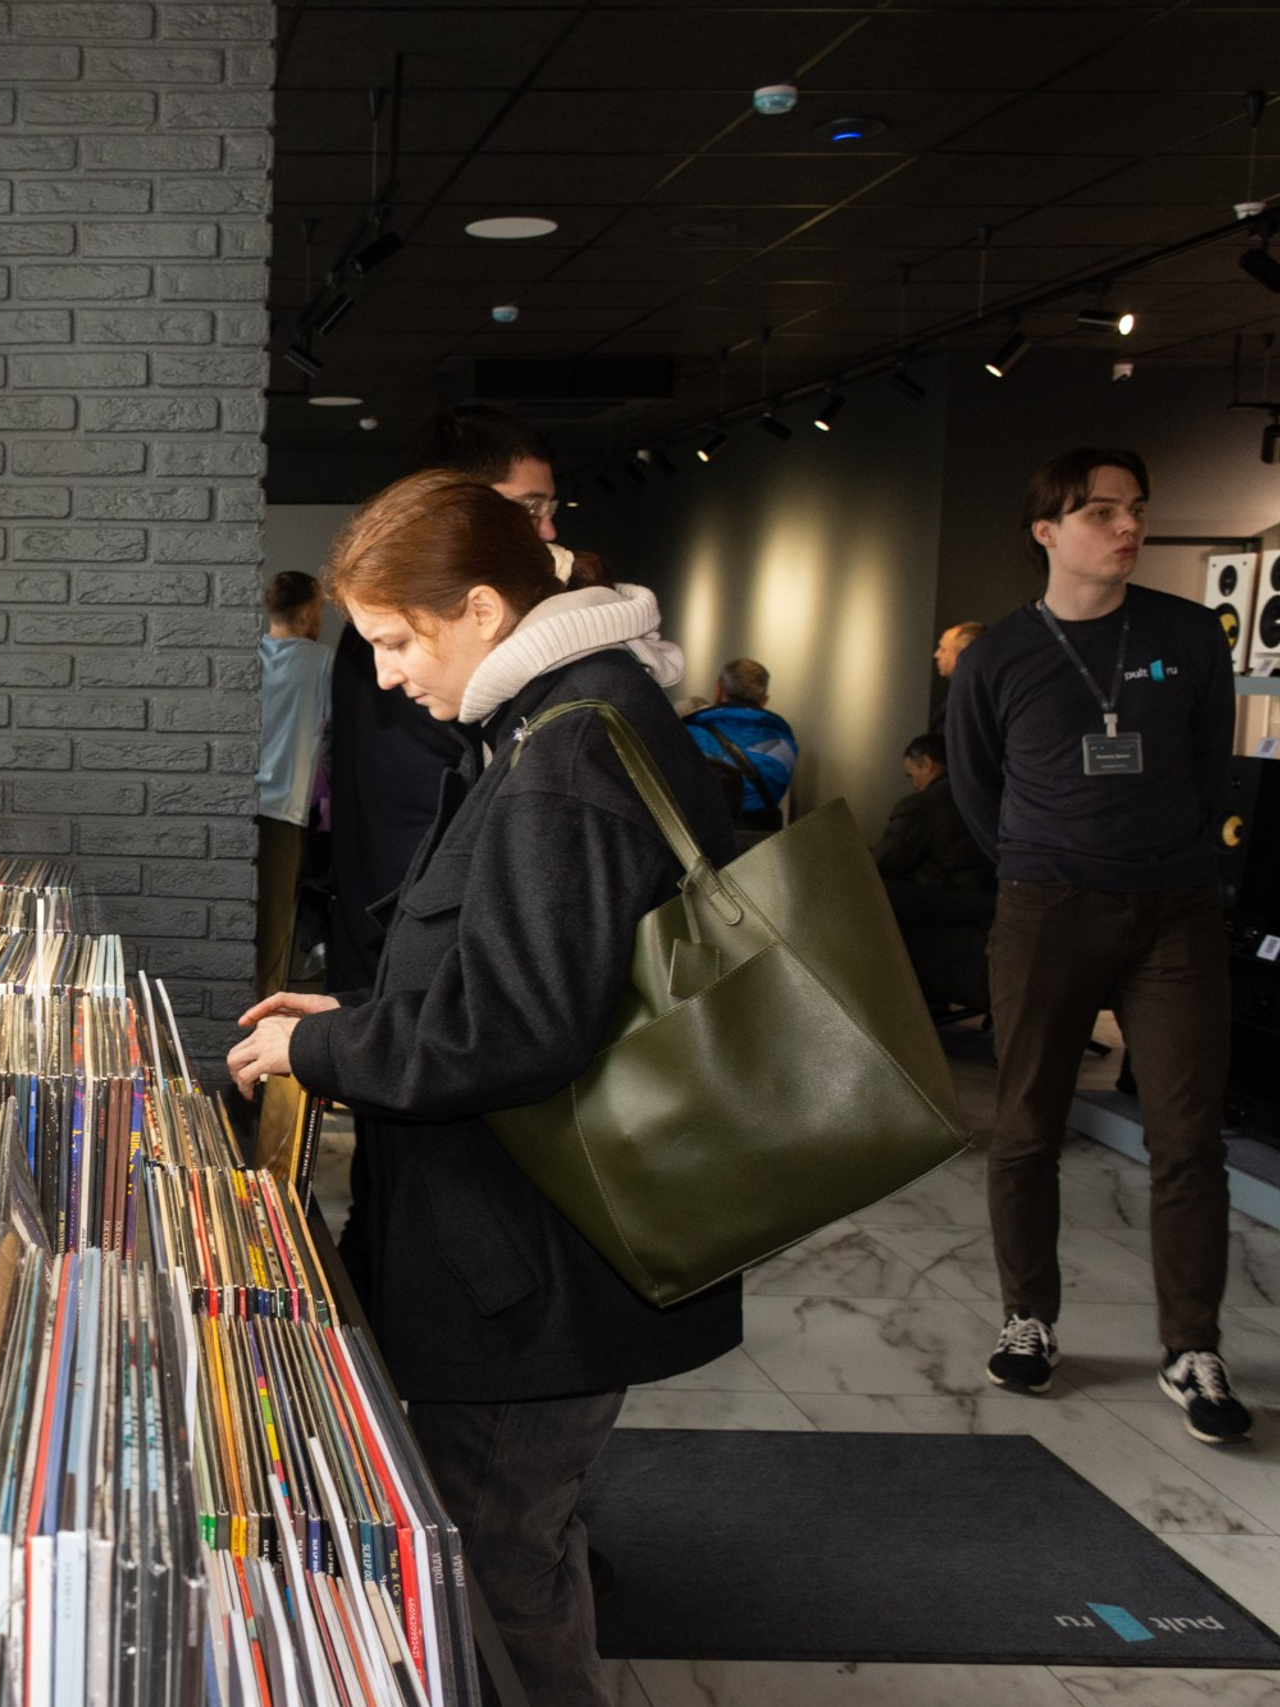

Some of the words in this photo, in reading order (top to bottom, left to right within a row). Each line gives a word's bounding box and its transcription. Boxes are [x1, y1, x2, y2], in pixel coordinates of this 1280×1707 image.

[1124, 667, 1149, 682] pult
[1166, 665, 1178, 675] ru
[362, 1543, 371, 1559] SLR
[363, 1559, 371, 1570] LP
[408, 1597, 420, 1659] 4601620992421
[1054, 1615, 1096, 1628] ru
[1148, 1615, 1226, 1633] pult
